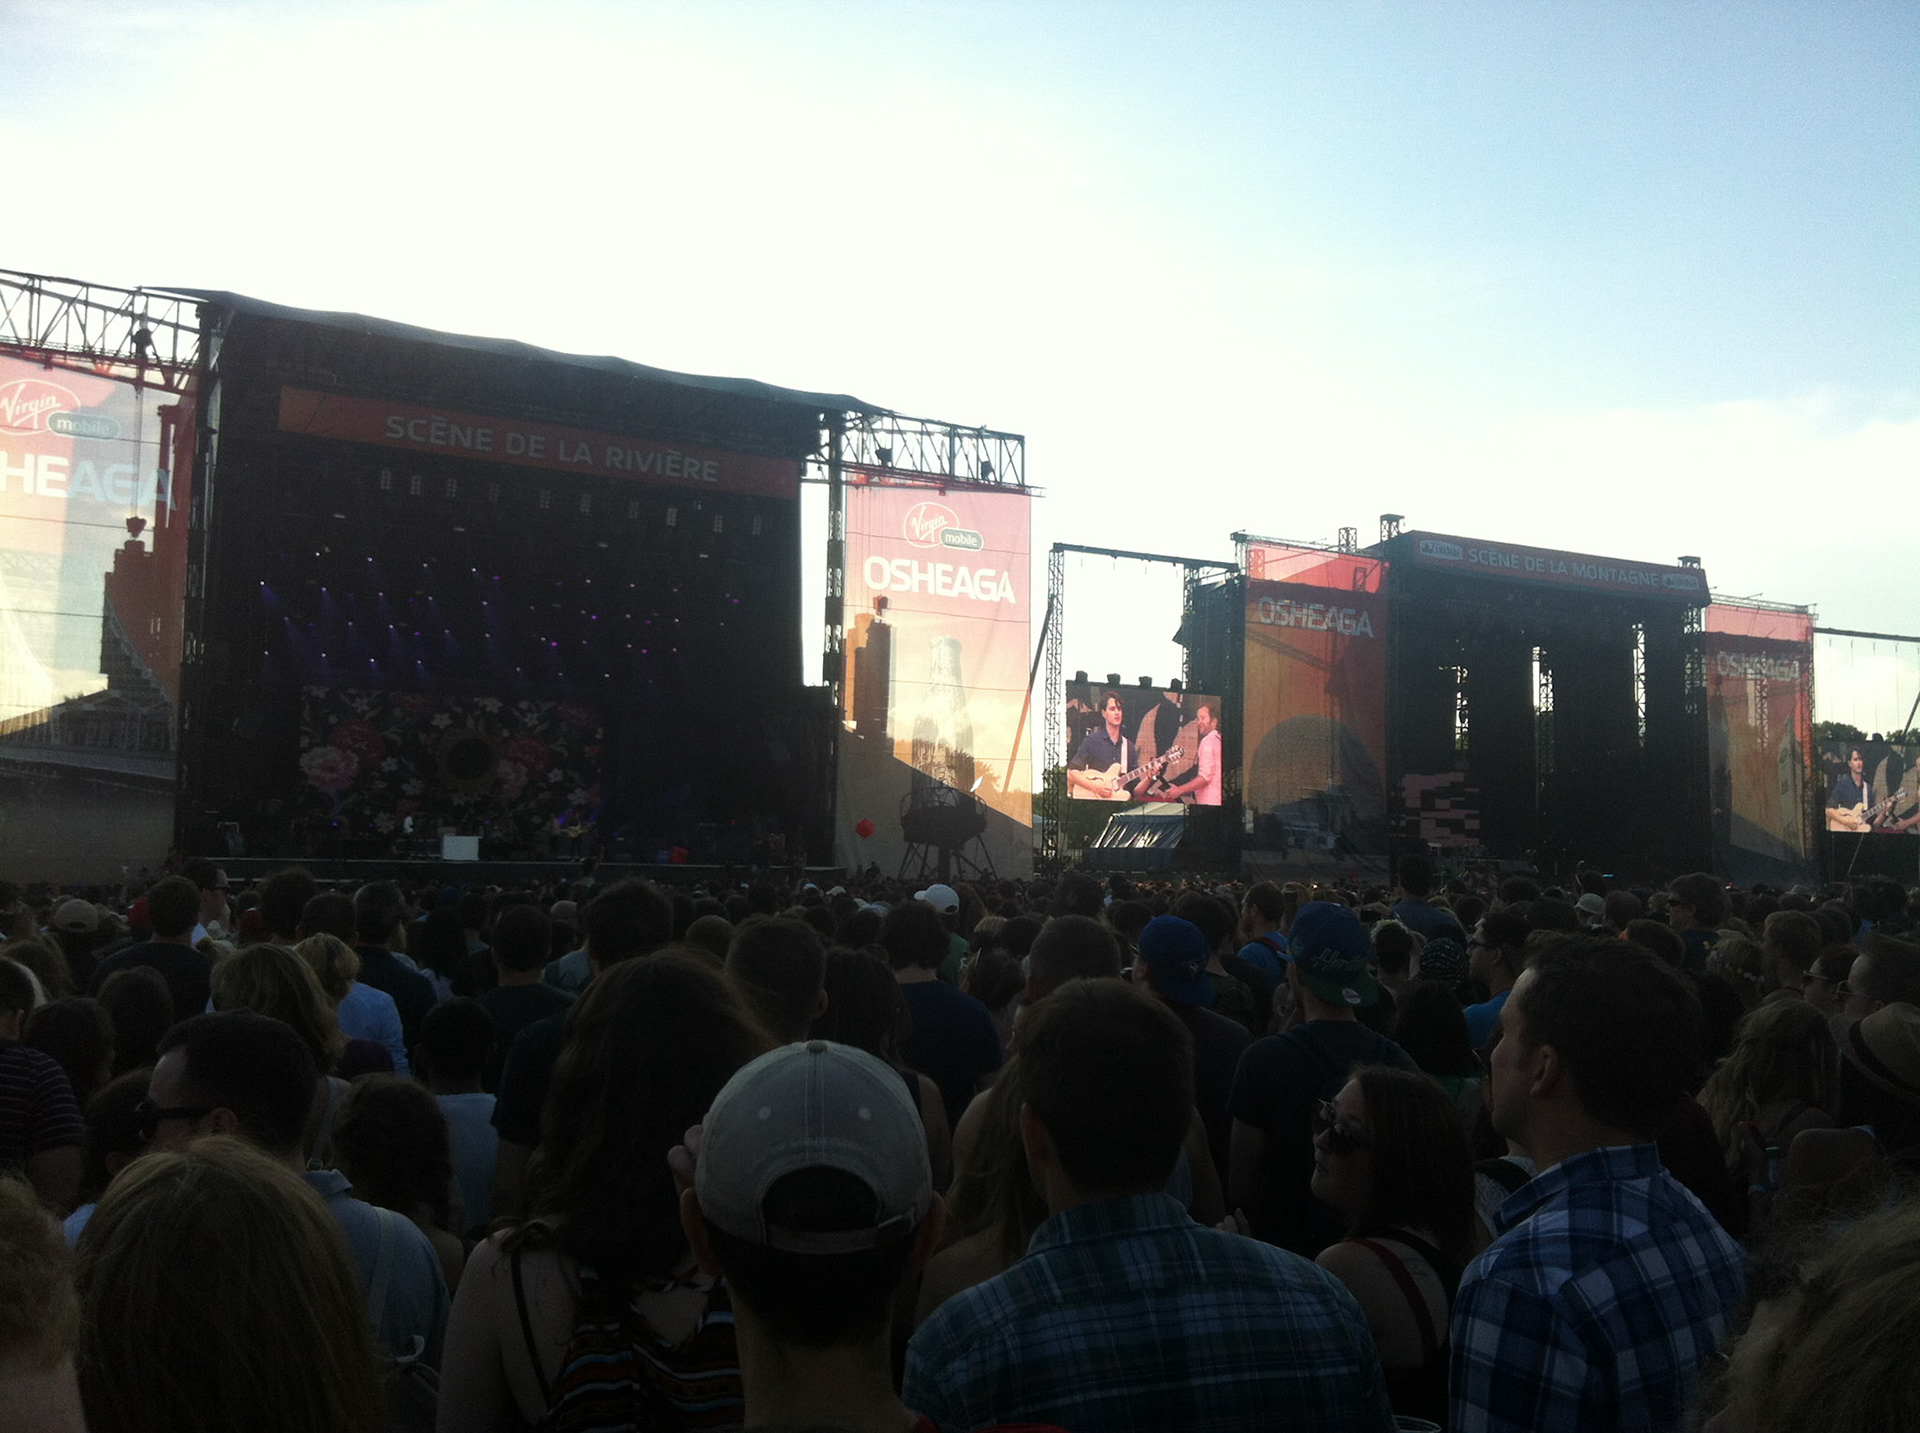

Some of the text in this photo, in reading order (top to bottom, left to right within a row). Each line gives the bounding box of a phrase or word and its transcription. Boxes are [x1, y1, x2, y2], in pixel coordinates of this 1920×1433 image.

[0, 383, 62, 430] Virgin
[56, 417, 111, 434] mobile
[506, 432, 547, 459] DE
[559, 439, 593, 465] LA
[911, 506, 948, 543] Virgin
[945, 533, 978, 547] mobile
[863, 556, 1016, 604] OSHEAGA
[1525, 556, 1546, 572] DE
[1549, 559, 1568, 576] LA
[1572, 561, 1660, 587] MONTAGNE
[1258, 595, 1376, 638] OSHEAGA
